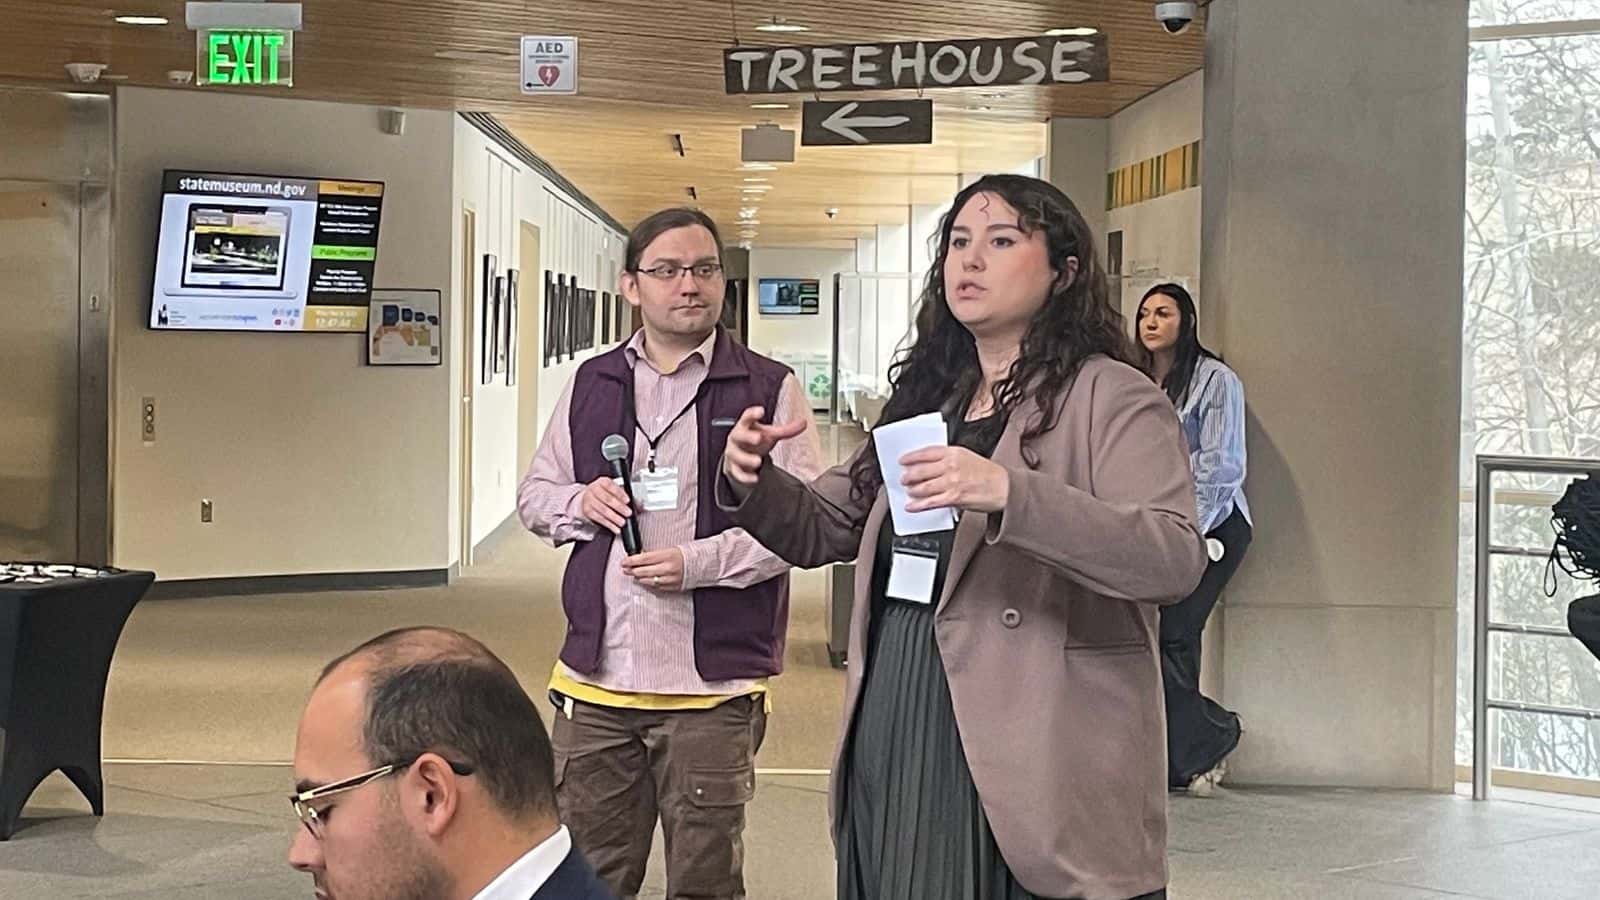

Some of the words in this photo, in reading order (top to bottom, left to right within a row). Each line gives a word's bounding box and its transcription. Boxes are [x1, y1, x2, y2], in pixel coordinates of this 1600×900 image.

[209, 34, 285, 84] EXIT
[535, 42, 563, 53] AED
[729, 41, 1096, 92] TREEHOUSE
[179, 178, 306, 198] statemuseum.nd.gov
